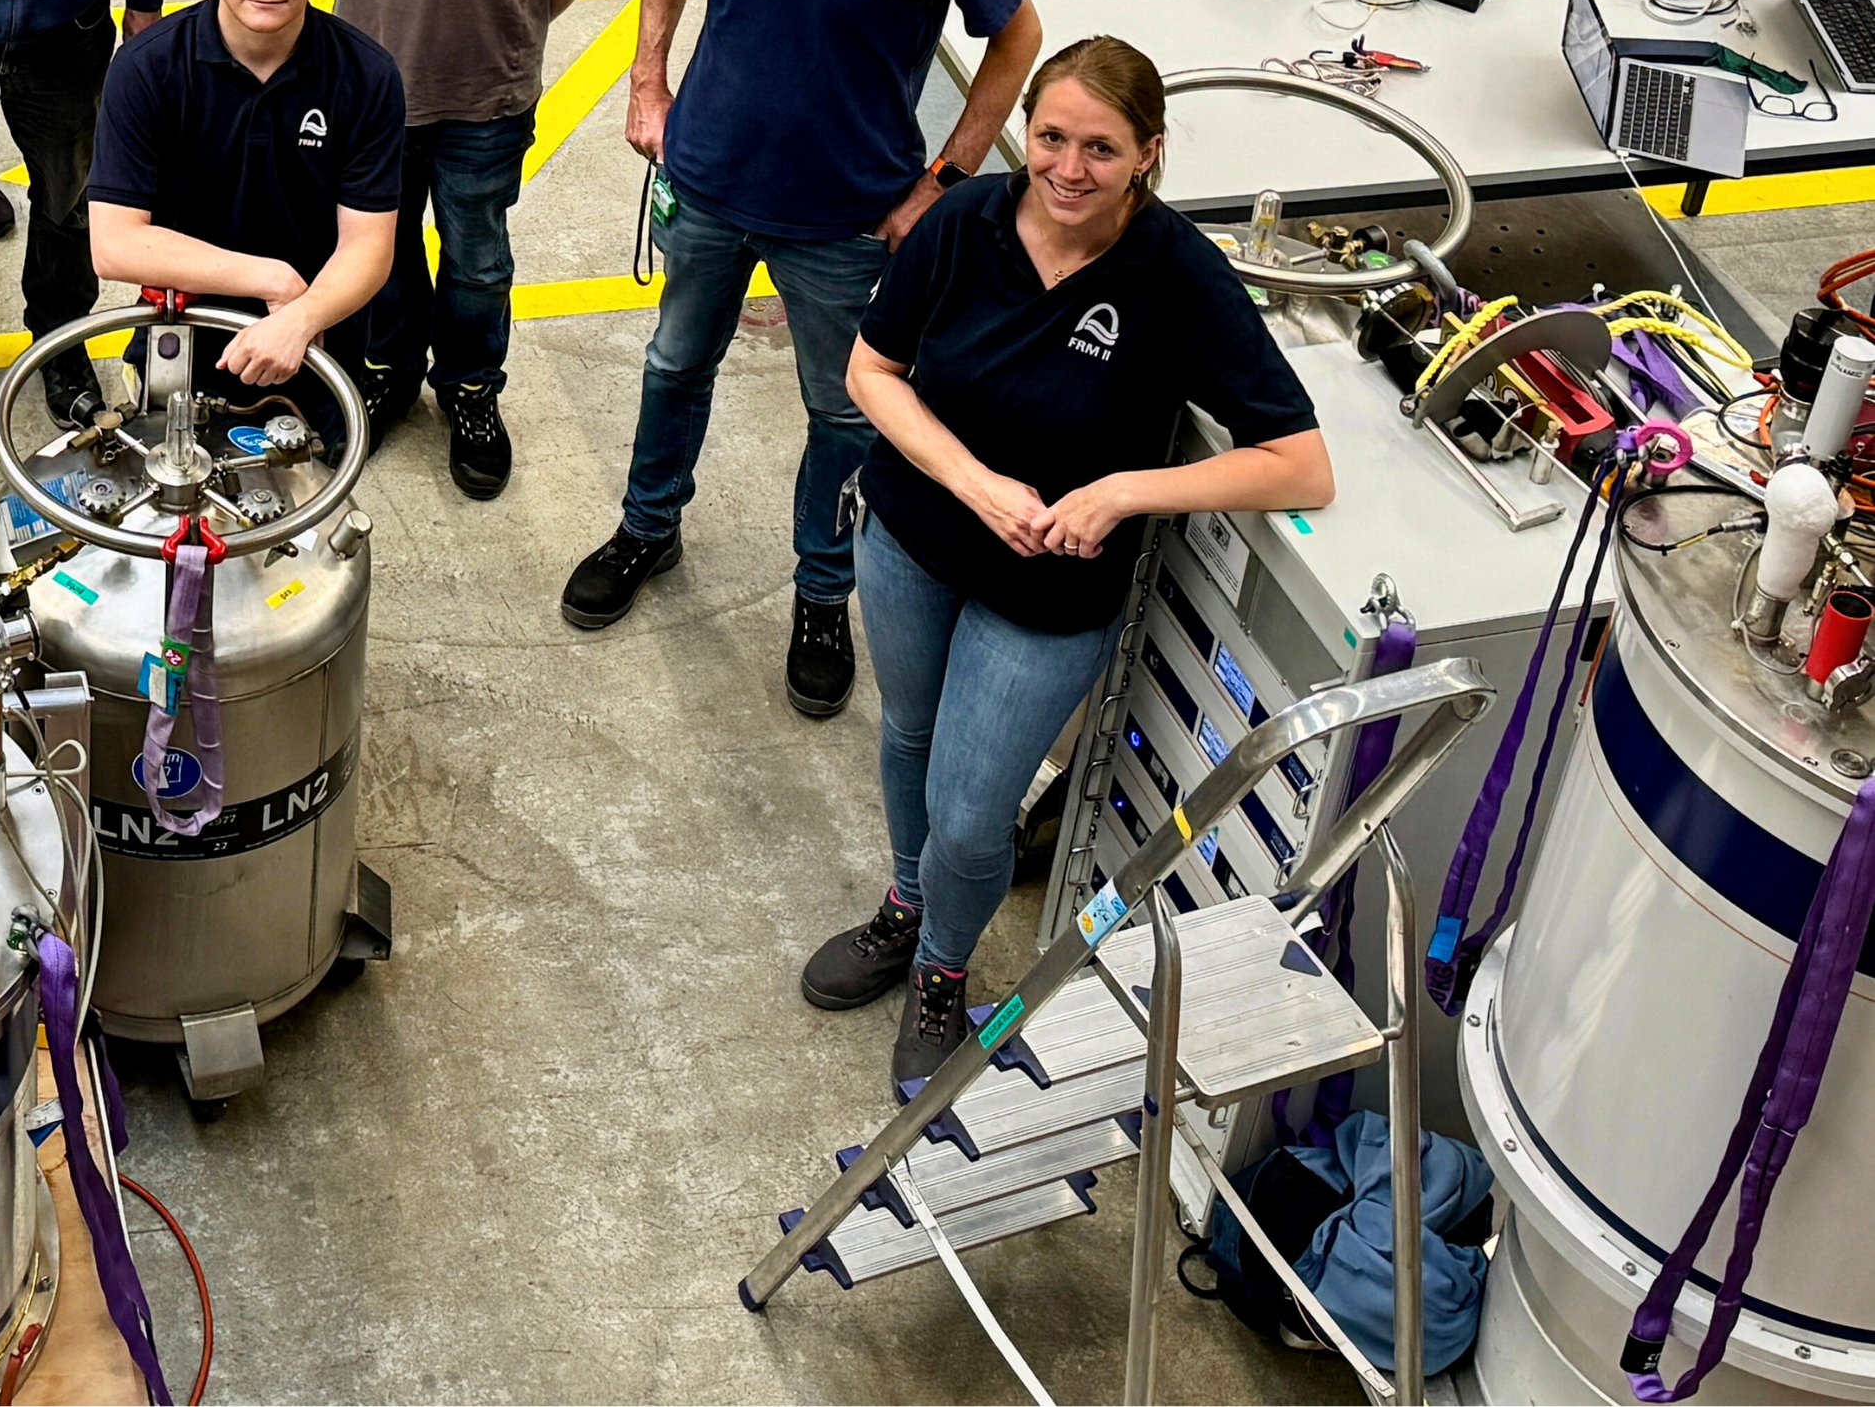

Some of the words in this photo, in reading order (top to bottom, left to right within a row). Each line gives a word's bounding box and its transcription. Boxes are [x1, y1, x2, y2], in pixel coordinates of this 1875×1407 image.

[1068, 336, 1100, 357] FRM
[1101, 349, 1111, 361] II
[262, 772, 329, 832] LN2
